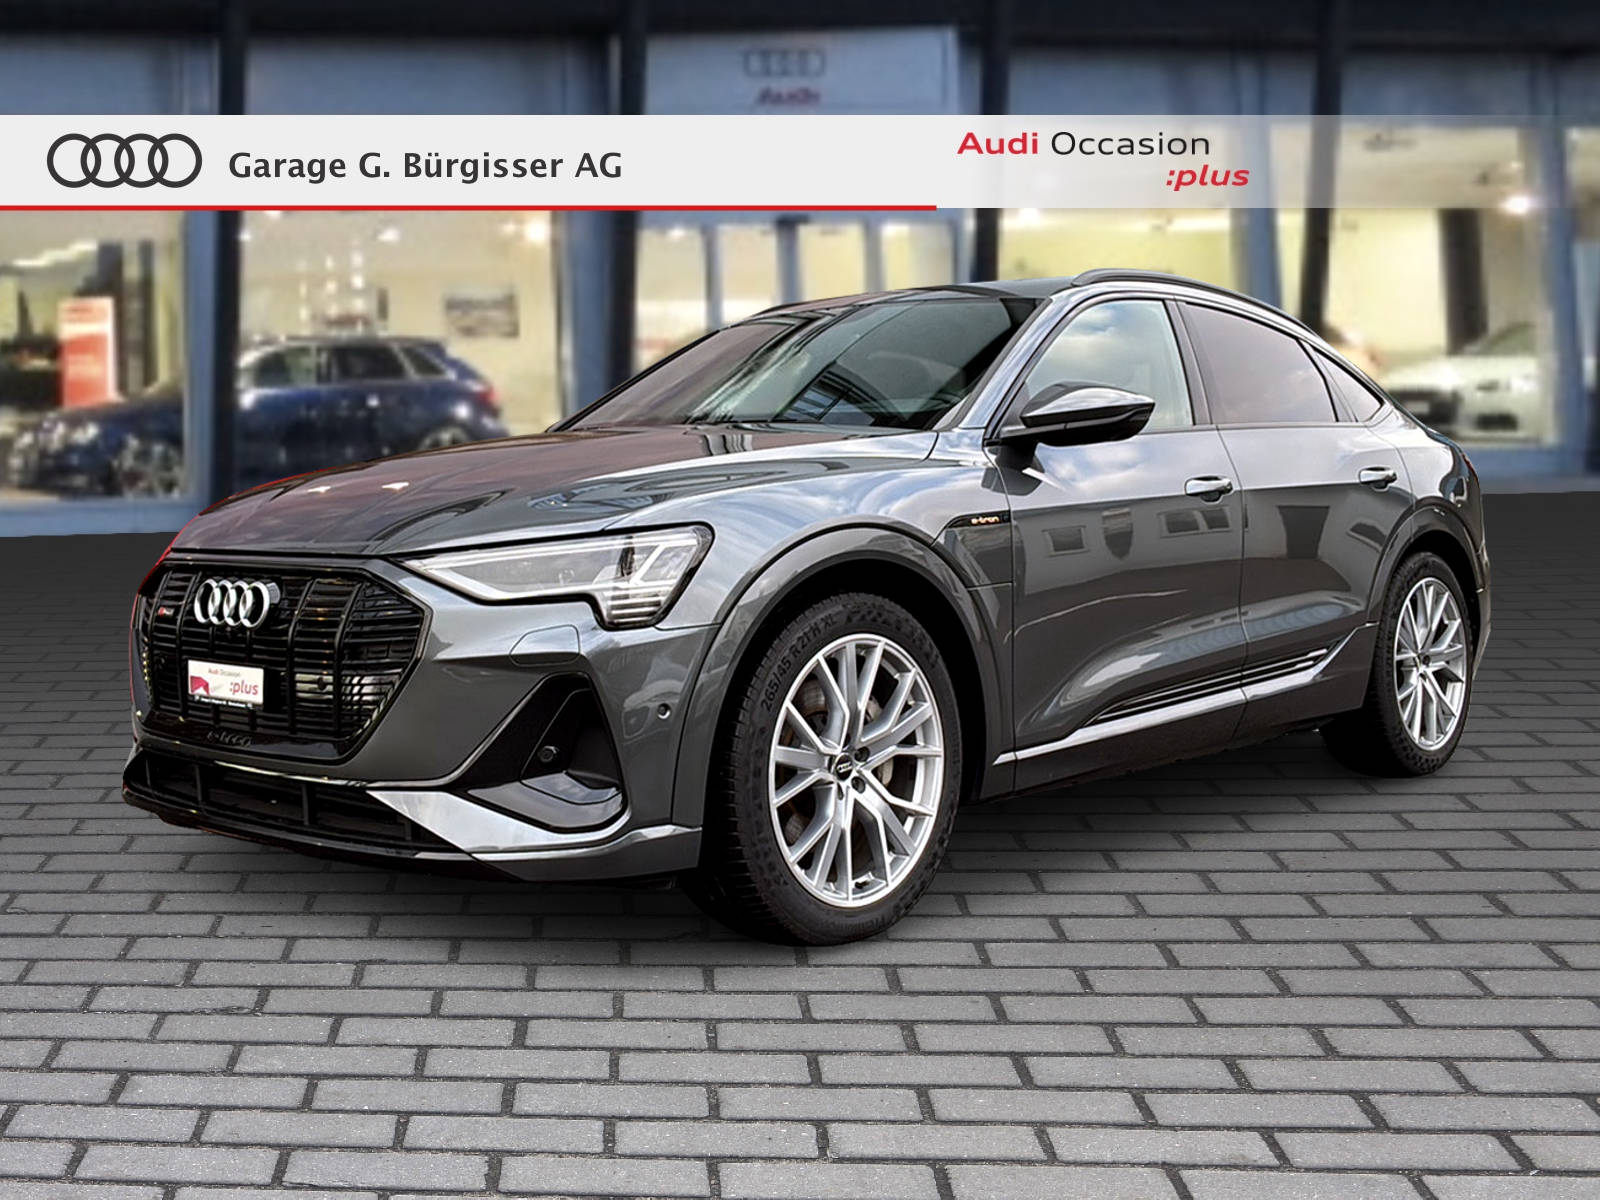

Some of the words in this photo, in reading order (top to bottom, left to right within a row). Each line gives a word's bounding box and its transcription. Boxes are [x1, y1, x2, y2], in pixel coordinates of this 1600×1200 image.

[970, 516, 1000, 526] e-tron
[229, 679, 259, 696] :plus
[760, 656, 792, 713] 265/45
